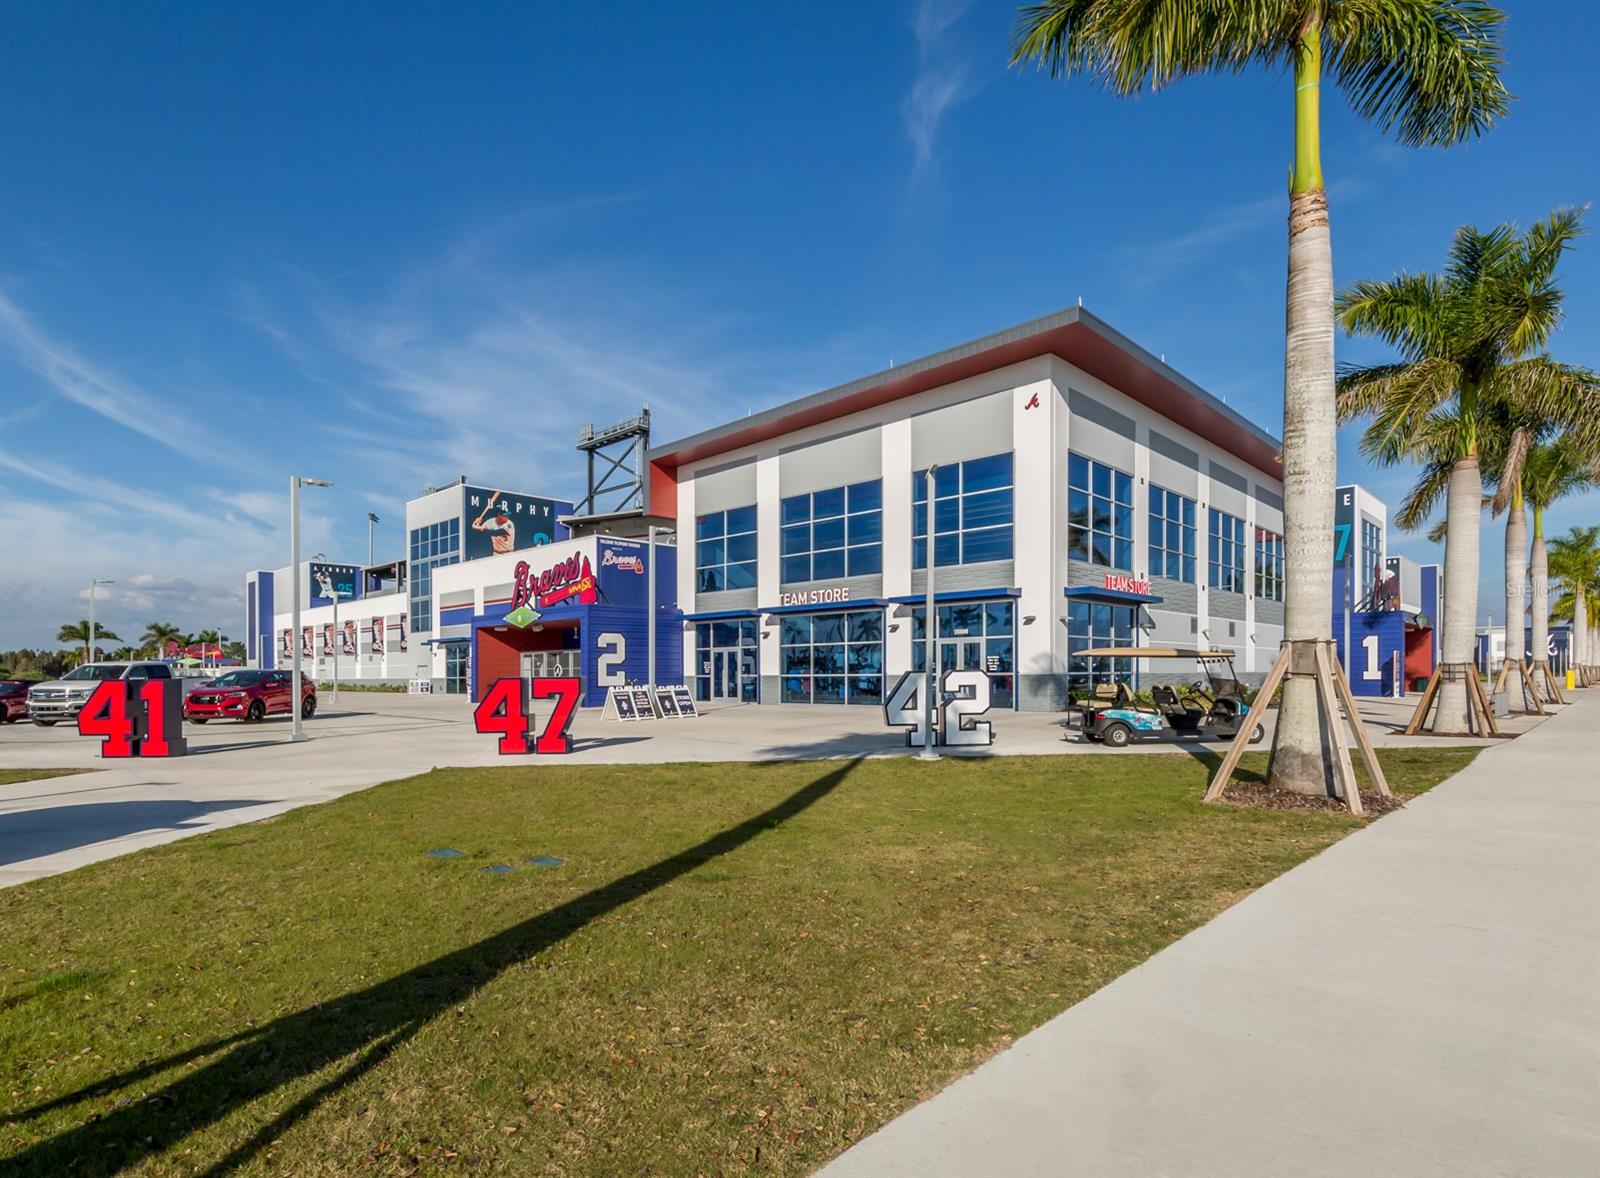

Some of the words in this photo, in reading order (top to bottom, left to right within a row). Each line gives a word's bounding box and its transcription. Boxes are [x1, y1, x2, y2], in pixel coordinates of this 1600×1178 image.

[470, 495, 549, 517] MURPHY
[512, 551, 581, 610] Braves
[778, 591, 809, 607] TEAM
[810, 587, 850, 605] STORE
[1104, 574, 1128, 592] TEAM
[1128, 578, 1152, 596] STORE
[597, 632, 628, 687] 2
[1361, 634, 1382, 681] 1
[77, 679, 170, 758] 41
[474, 677, 582, 755] 47
[885, 670, 992, 747] 42
